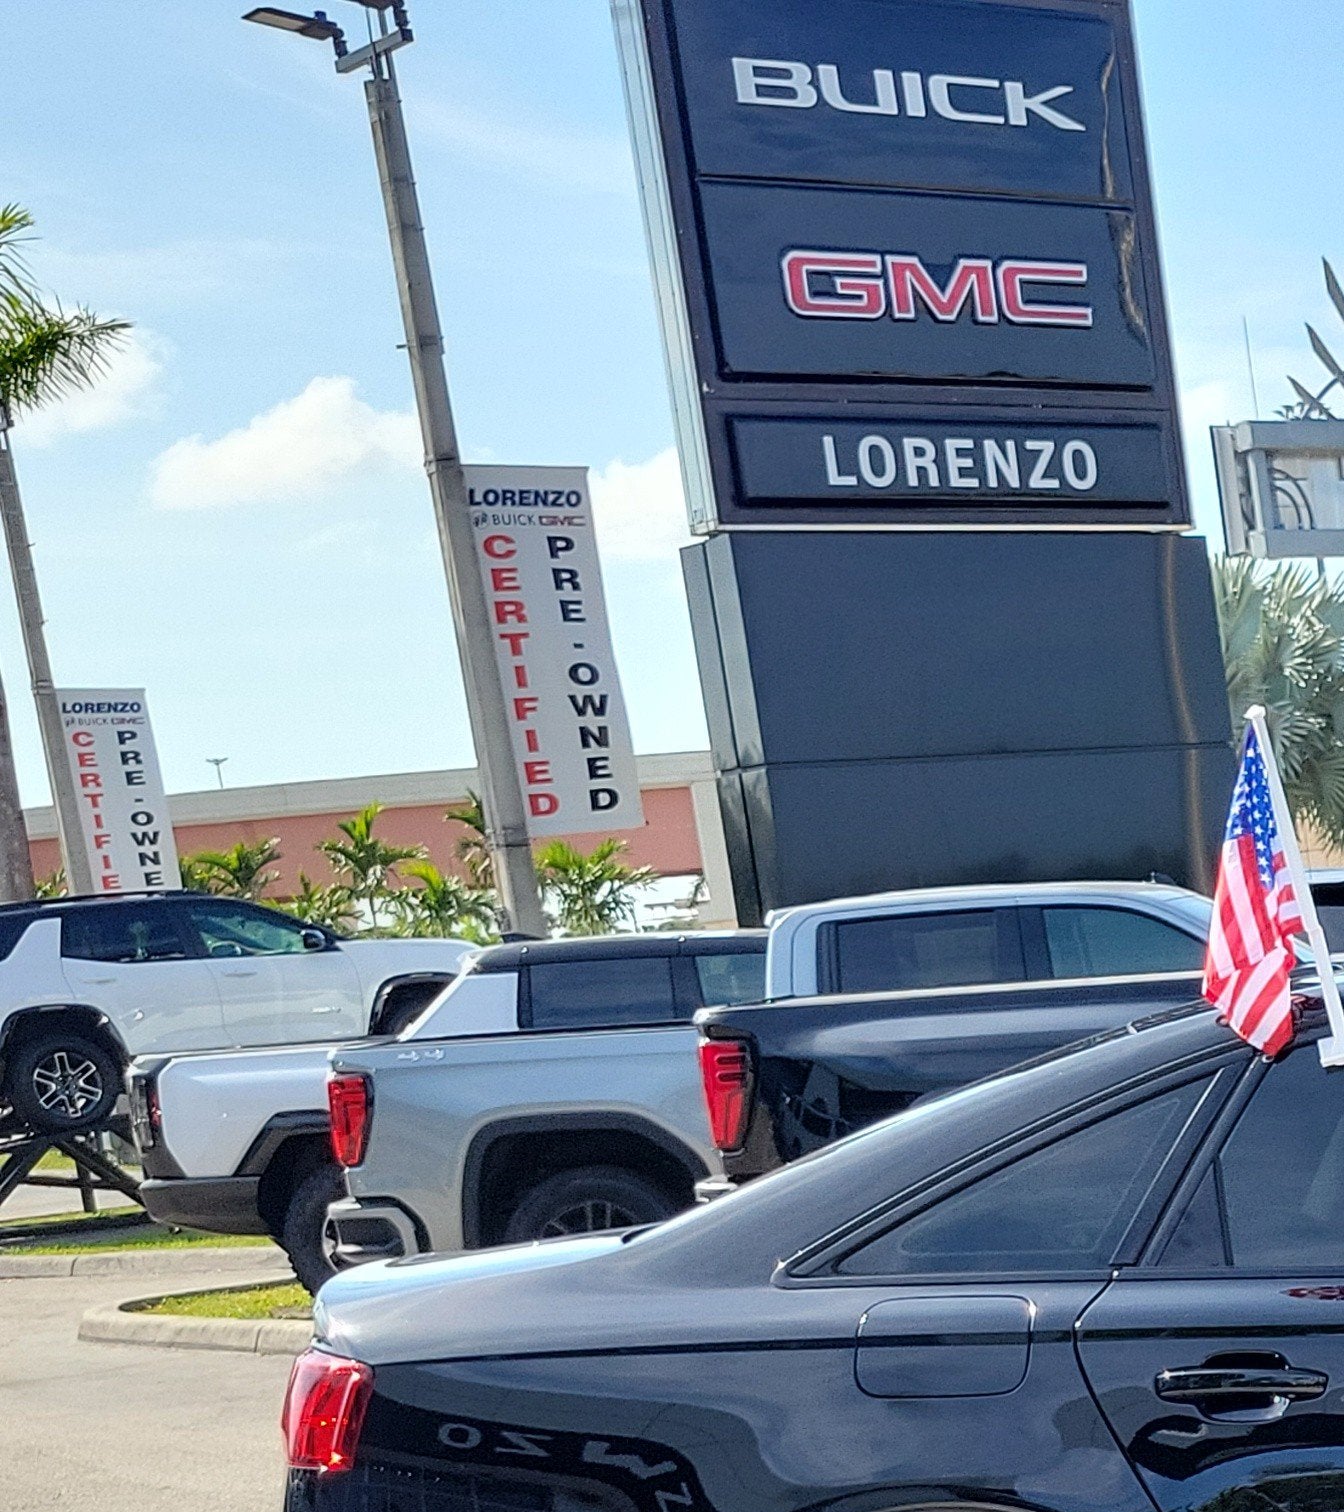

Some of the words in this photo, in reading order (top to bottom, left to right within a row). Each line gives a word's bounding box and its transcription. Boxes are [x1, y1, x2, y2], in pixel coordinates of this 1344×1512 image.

[731, 57, 1086, 131] BUICK
[782, 250, 1093, 327] GMC
[468, 488, 582, 507] LORENZO
[822, 435, 1098, 490] LORENZO
[492, 513, 536, 526] BUICK
[538, 515, 586, 527] GMC
[62, 702, 142, 714] LORENZO
[483, 535, 560, 817] CERTIFIED
[72, 731, 122, 890] CERTIFIE
[117, 731, 164, 887] PRE-OWNE
